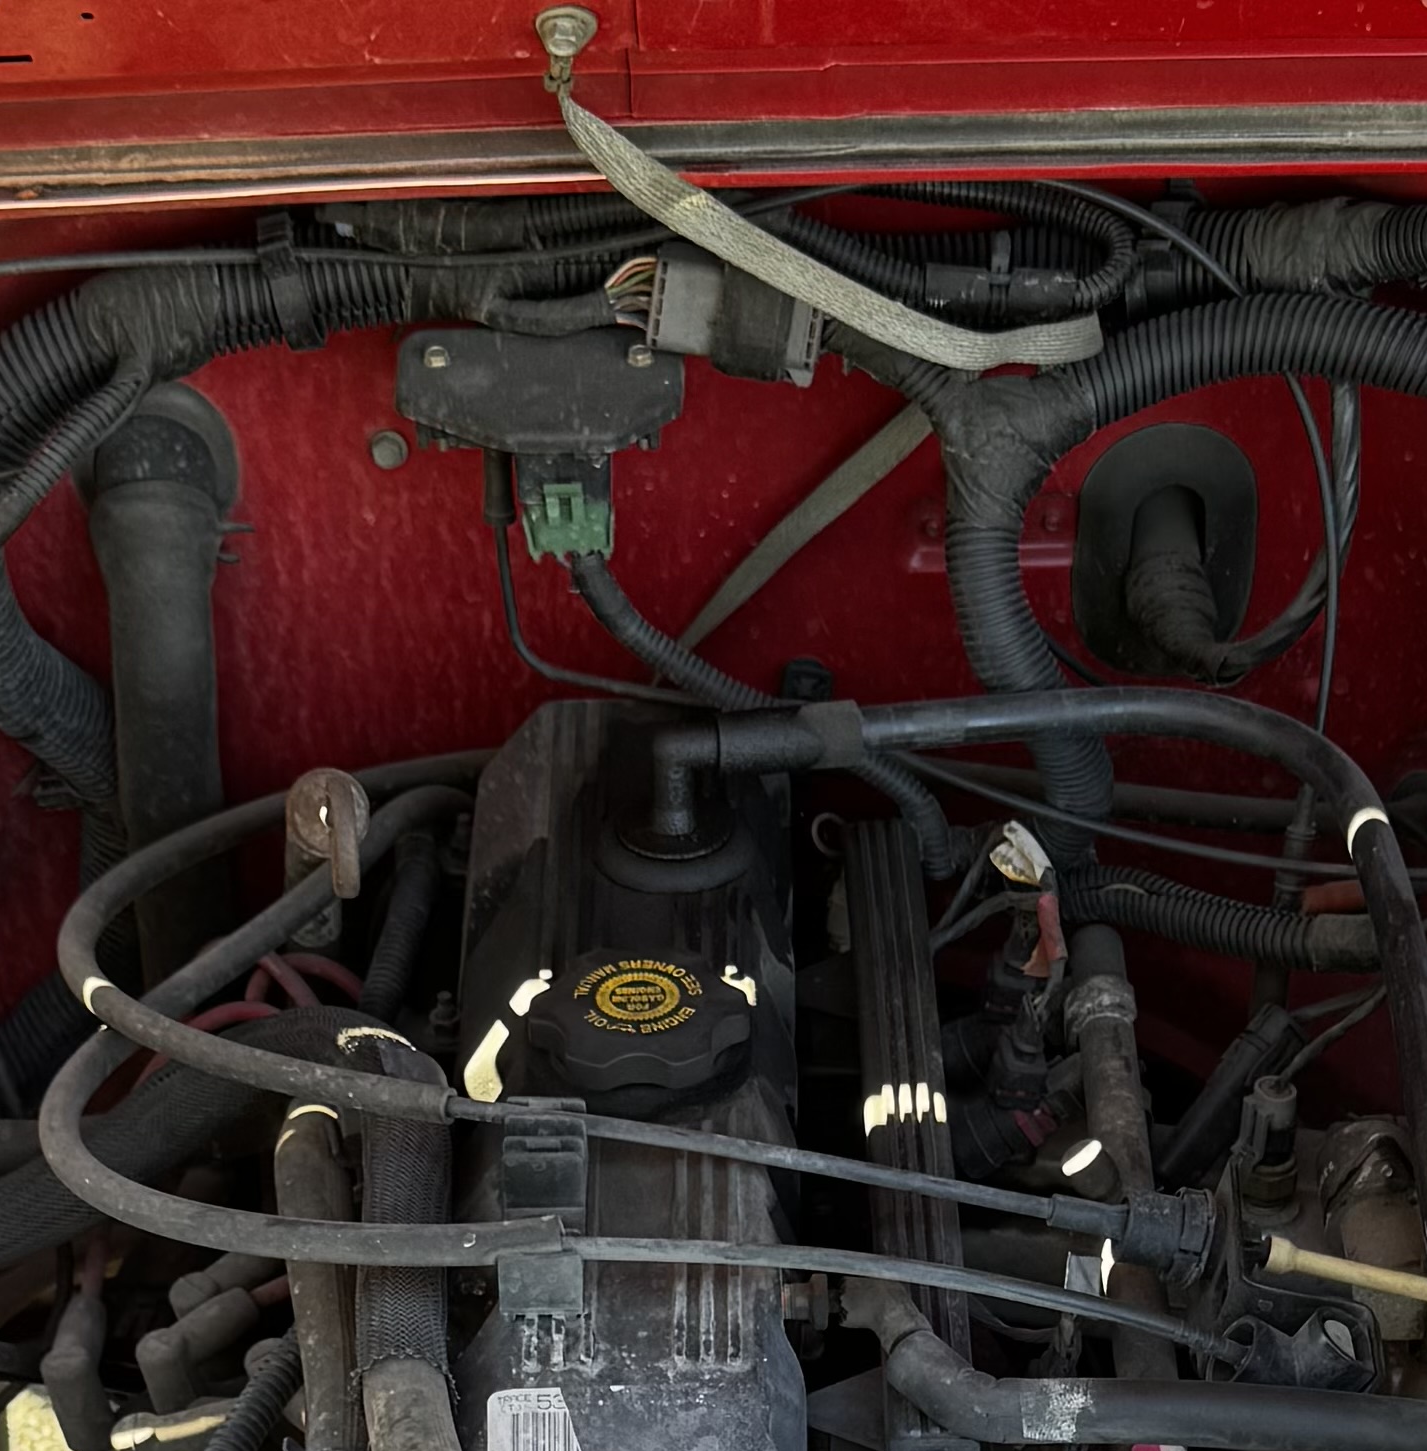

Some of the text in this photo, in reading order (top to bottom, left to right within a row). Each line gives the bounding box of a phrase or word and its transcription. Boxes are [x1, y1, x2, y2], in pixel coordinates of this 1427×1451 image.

[574, 964, 618, 999] MANUAL
[677, 973, 703, 996] SEE
[584, 1009, 608, 1028] OIL
